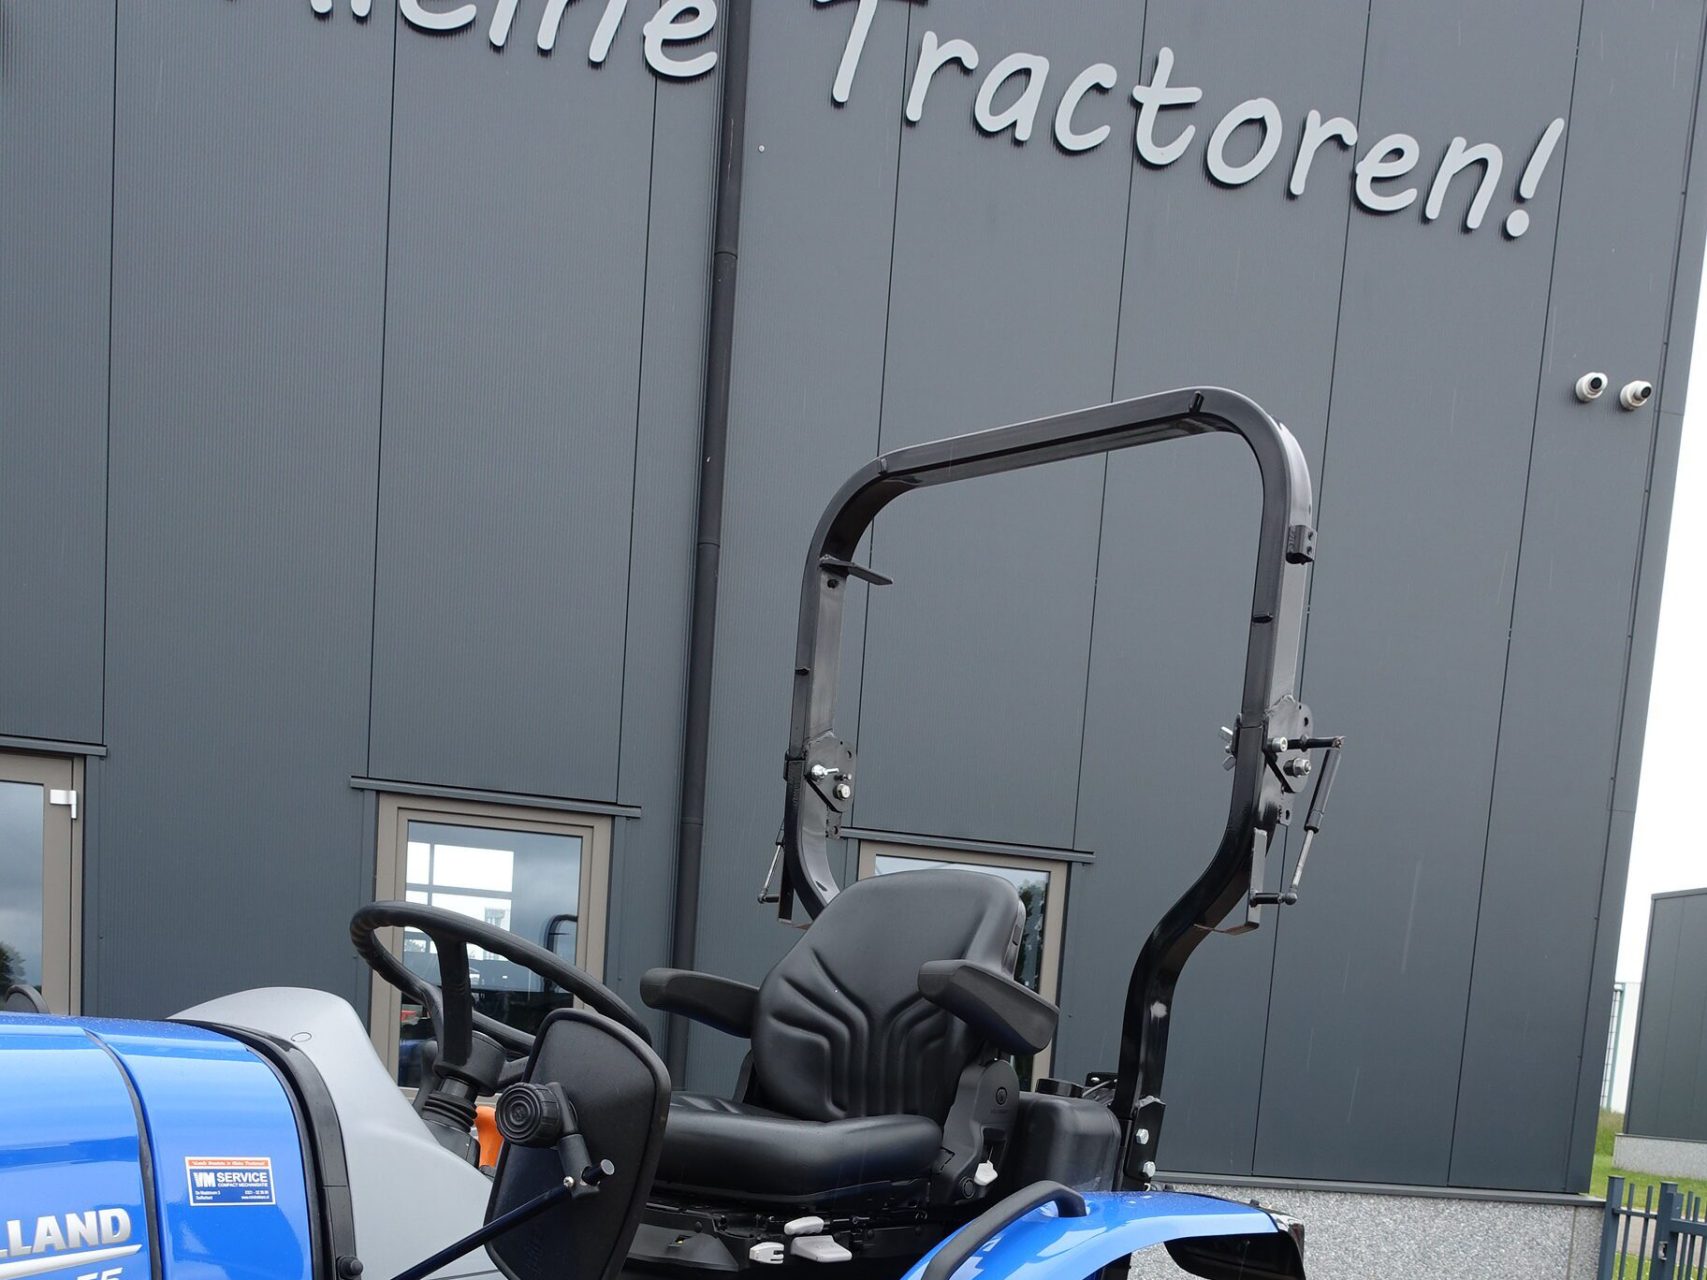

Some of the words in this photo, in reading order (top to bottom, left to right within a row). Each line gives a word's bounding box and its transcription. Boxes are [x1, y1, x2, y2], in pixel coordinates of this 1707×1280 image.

[815, 0, 1566, 238] Tractoren!
[216, 1171, 268, 1183] SERVICE
[0, 1207, 132, 1258] LAND
